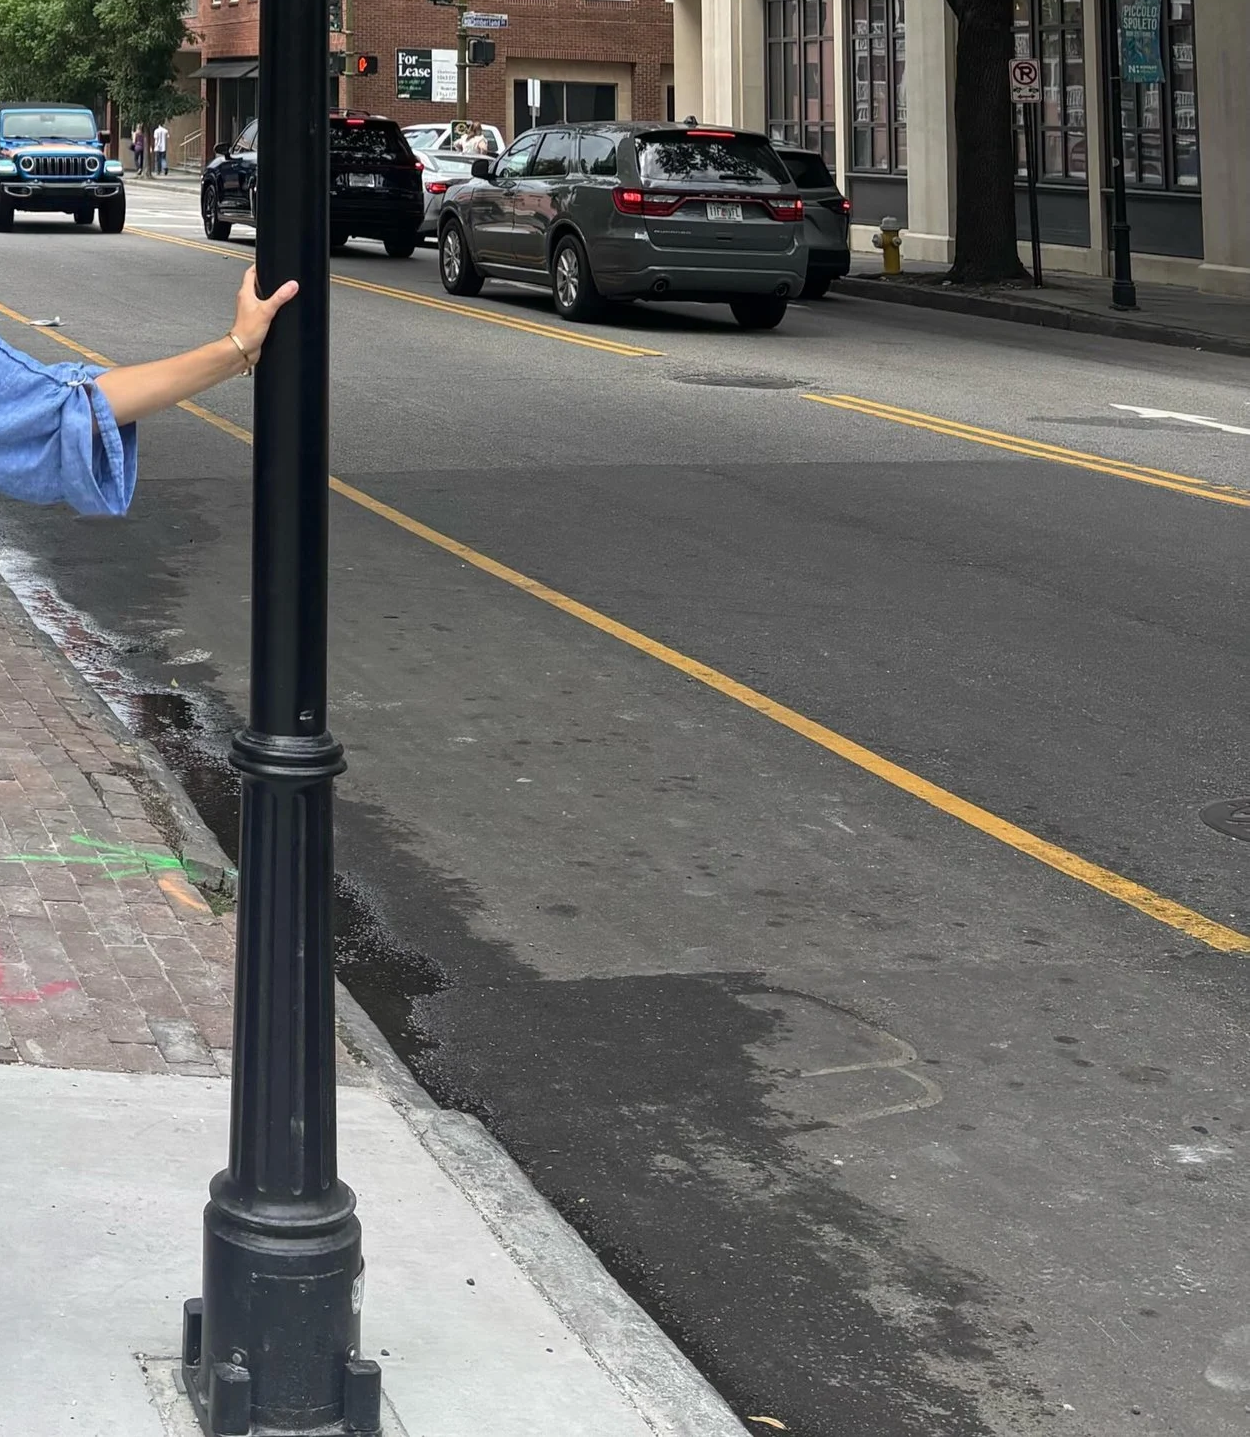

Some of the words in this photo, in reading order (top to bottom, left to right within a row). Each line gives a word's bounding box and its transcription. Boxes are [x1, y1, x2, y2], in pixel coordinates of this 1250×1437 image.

[1124, 5, 1158, 18] PICCOLO
[1123, 17, 1157, 31] SPOLETO
[398, 52, 418, 65] For
[398, 65, 431, 78] Lease
